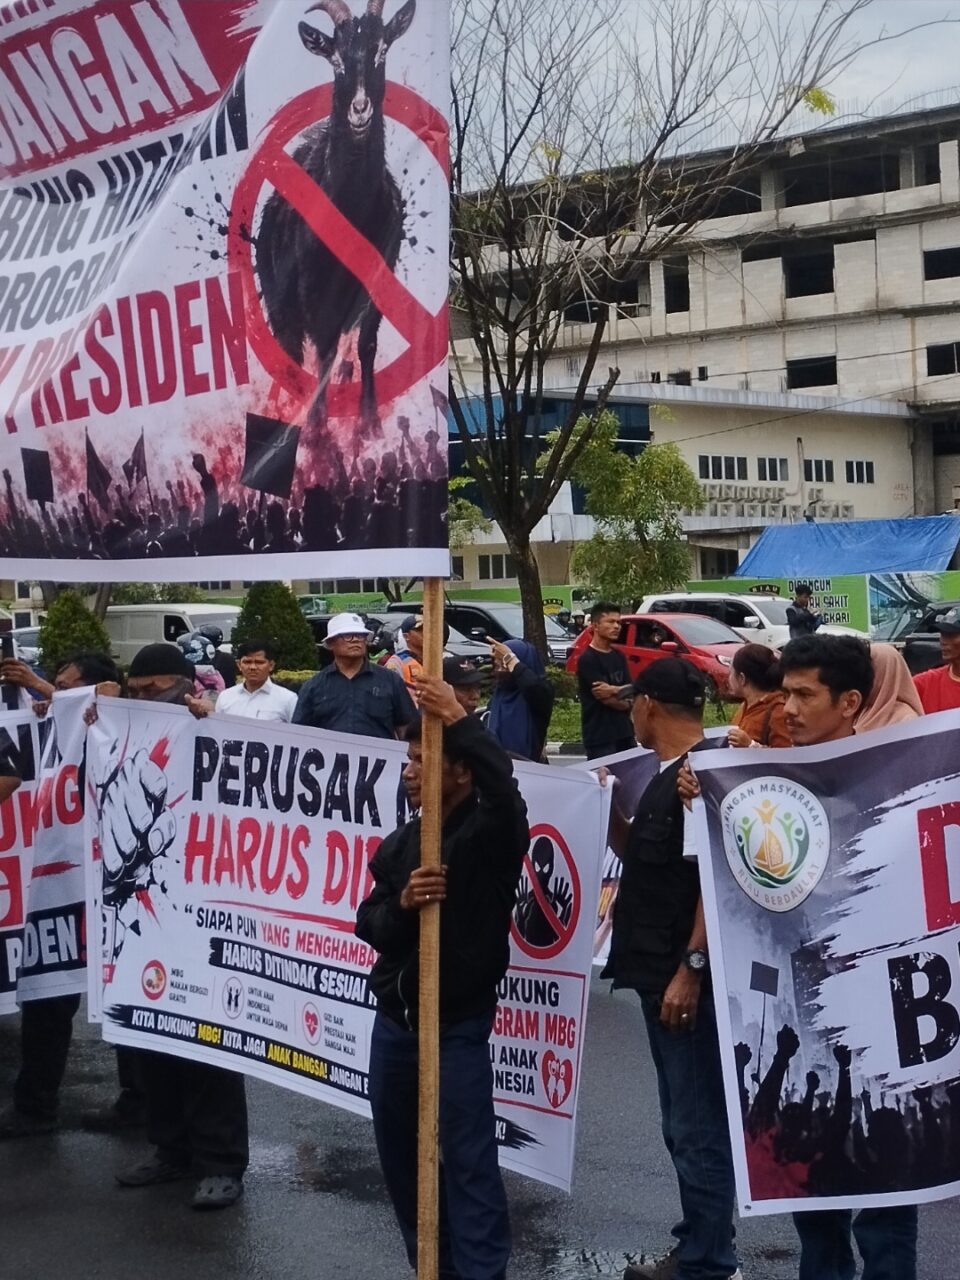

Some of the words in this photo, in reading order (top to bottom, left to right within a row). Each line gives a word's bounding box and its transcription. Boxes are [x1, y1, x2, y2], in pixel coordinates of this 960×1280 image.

[192, 736, 387, 828] PERUSAK
[760, 783, 823, 828] MASYARAKAT
[184, 810, 311, 901] HARUS
[737, 868, 760, 899] RIAU
[764, 863, 821, 906] BERDAULAT
[236, 915, 257, 940] PUN
[261, 921, 290, 949] YANG
[295, 928, 377, 968] MENGHAMBA
[222, 941, 262, 973] HARUS
[264, 952, 318, 990] DITINDAK
[319, 968, 367, 1004] SESUAI
[496, 975, 559, 1008] UKUNG
[493, 1005, 540, 1042] GRAM
[545, 1012, 576, 1050] MBG
[131, 1009, 155, 1030] KITA
[157, 1014, 197, 1038] DUKUNG
[197, 1023, 222, 1044] MBG!
[222, 1030, 243, 1050] KITA
[243, 1036, 266, 1058] JAGA
[267, 1043, 292, 1066] ANAK
[292, 1050, 328, 1079] BANGSA!
[329, 1065, 362, 1093] JANGAN
[500, 1045, 538, 1071] ANAK
[495, 1069, 535, 1096] NESIA
